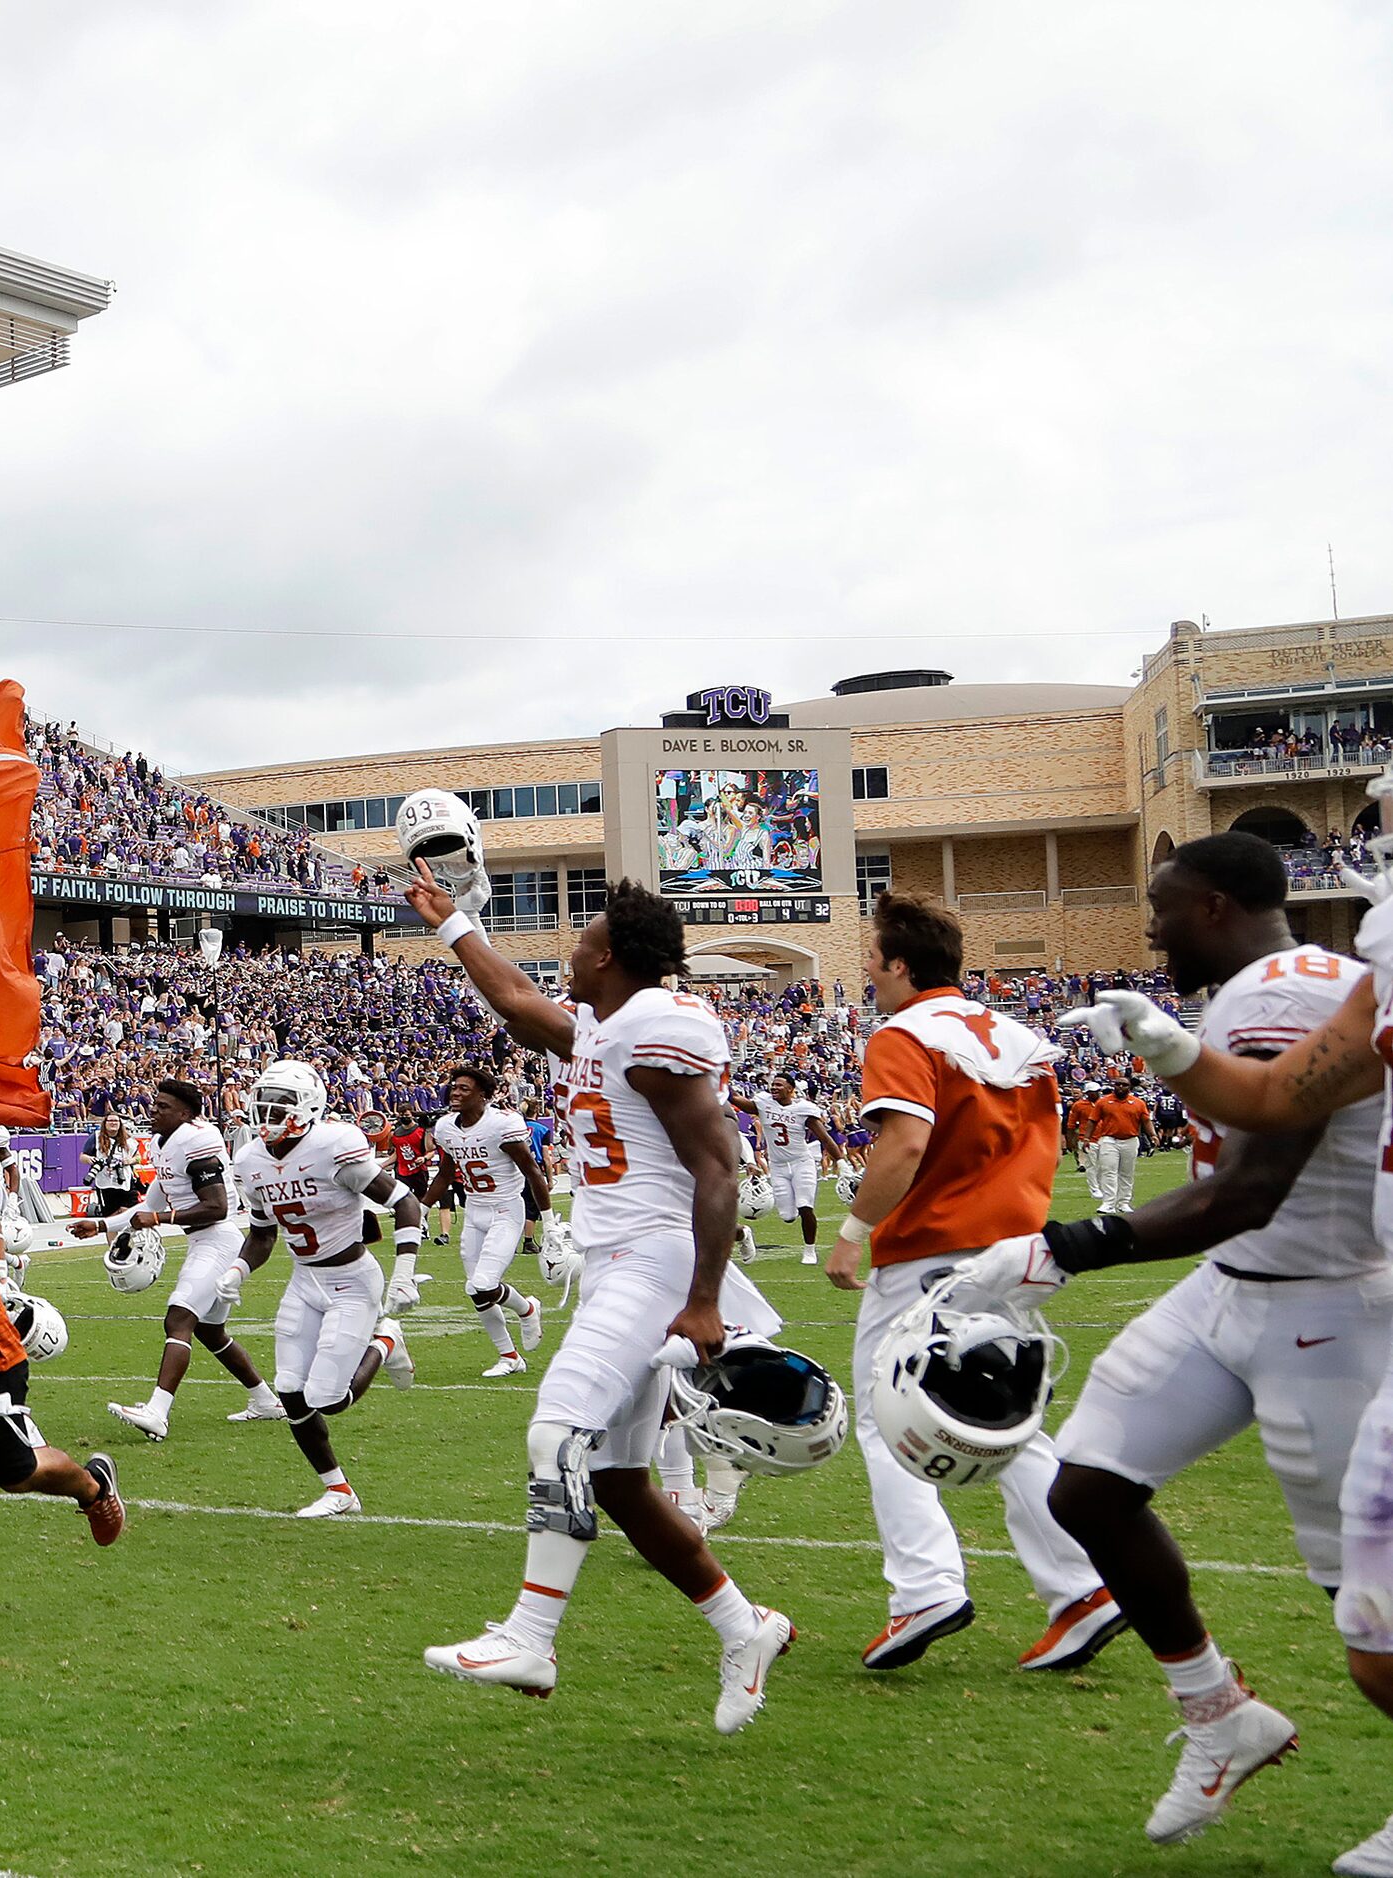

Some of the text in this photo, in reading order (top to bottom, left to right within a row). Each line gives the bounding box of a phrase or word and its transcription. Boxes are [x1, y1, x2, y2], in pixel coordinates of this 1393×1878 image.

[701, 685, 772, 726] TCU
[662, 739, 808, 754] DAVE E. BLOXOM, SR.
[1285, 771, 1310, 780] 1920
[1327, 767, 1351, 777] 1929
[405, 800, 433, 827] 93
[407, 824, 446, 845] LONGHORNS
[729, 869, 761, 890] TCU
[52, 878, 102, 903] FAITH,
[106, 883, 164, 906] FOLLOW
[166, 889, 236, 912] THROUGH
[258, 896, 307, 916] PRAISE
[309, 900, 326, 918] TO
[329, 902, 367, 923] THEE,
[369, 905, 395, 923] TCU
[673, 901, 690, 911] TCU
[794, 900, 806, 910] UT
[815, 904, 829, 916] 32
[728, 914, 734, 923] 0
[752, 914, 758, 923] 3
[782, 909, 790, 920] 4
[1261, 955, 1341, 983] 18
[765, 1110, 796, 1124] TEXAS
[569, 1092, 629, 1186] 3
[770, 1122, 789, 1147] 3
[449, 1146, 489, 1160] TEXAS
[255, 1177, 318, 1203] TEXAS
[272, 1201, 320, 1257] 5
[934, 1428, 1018, 1458] LONGHORNS
